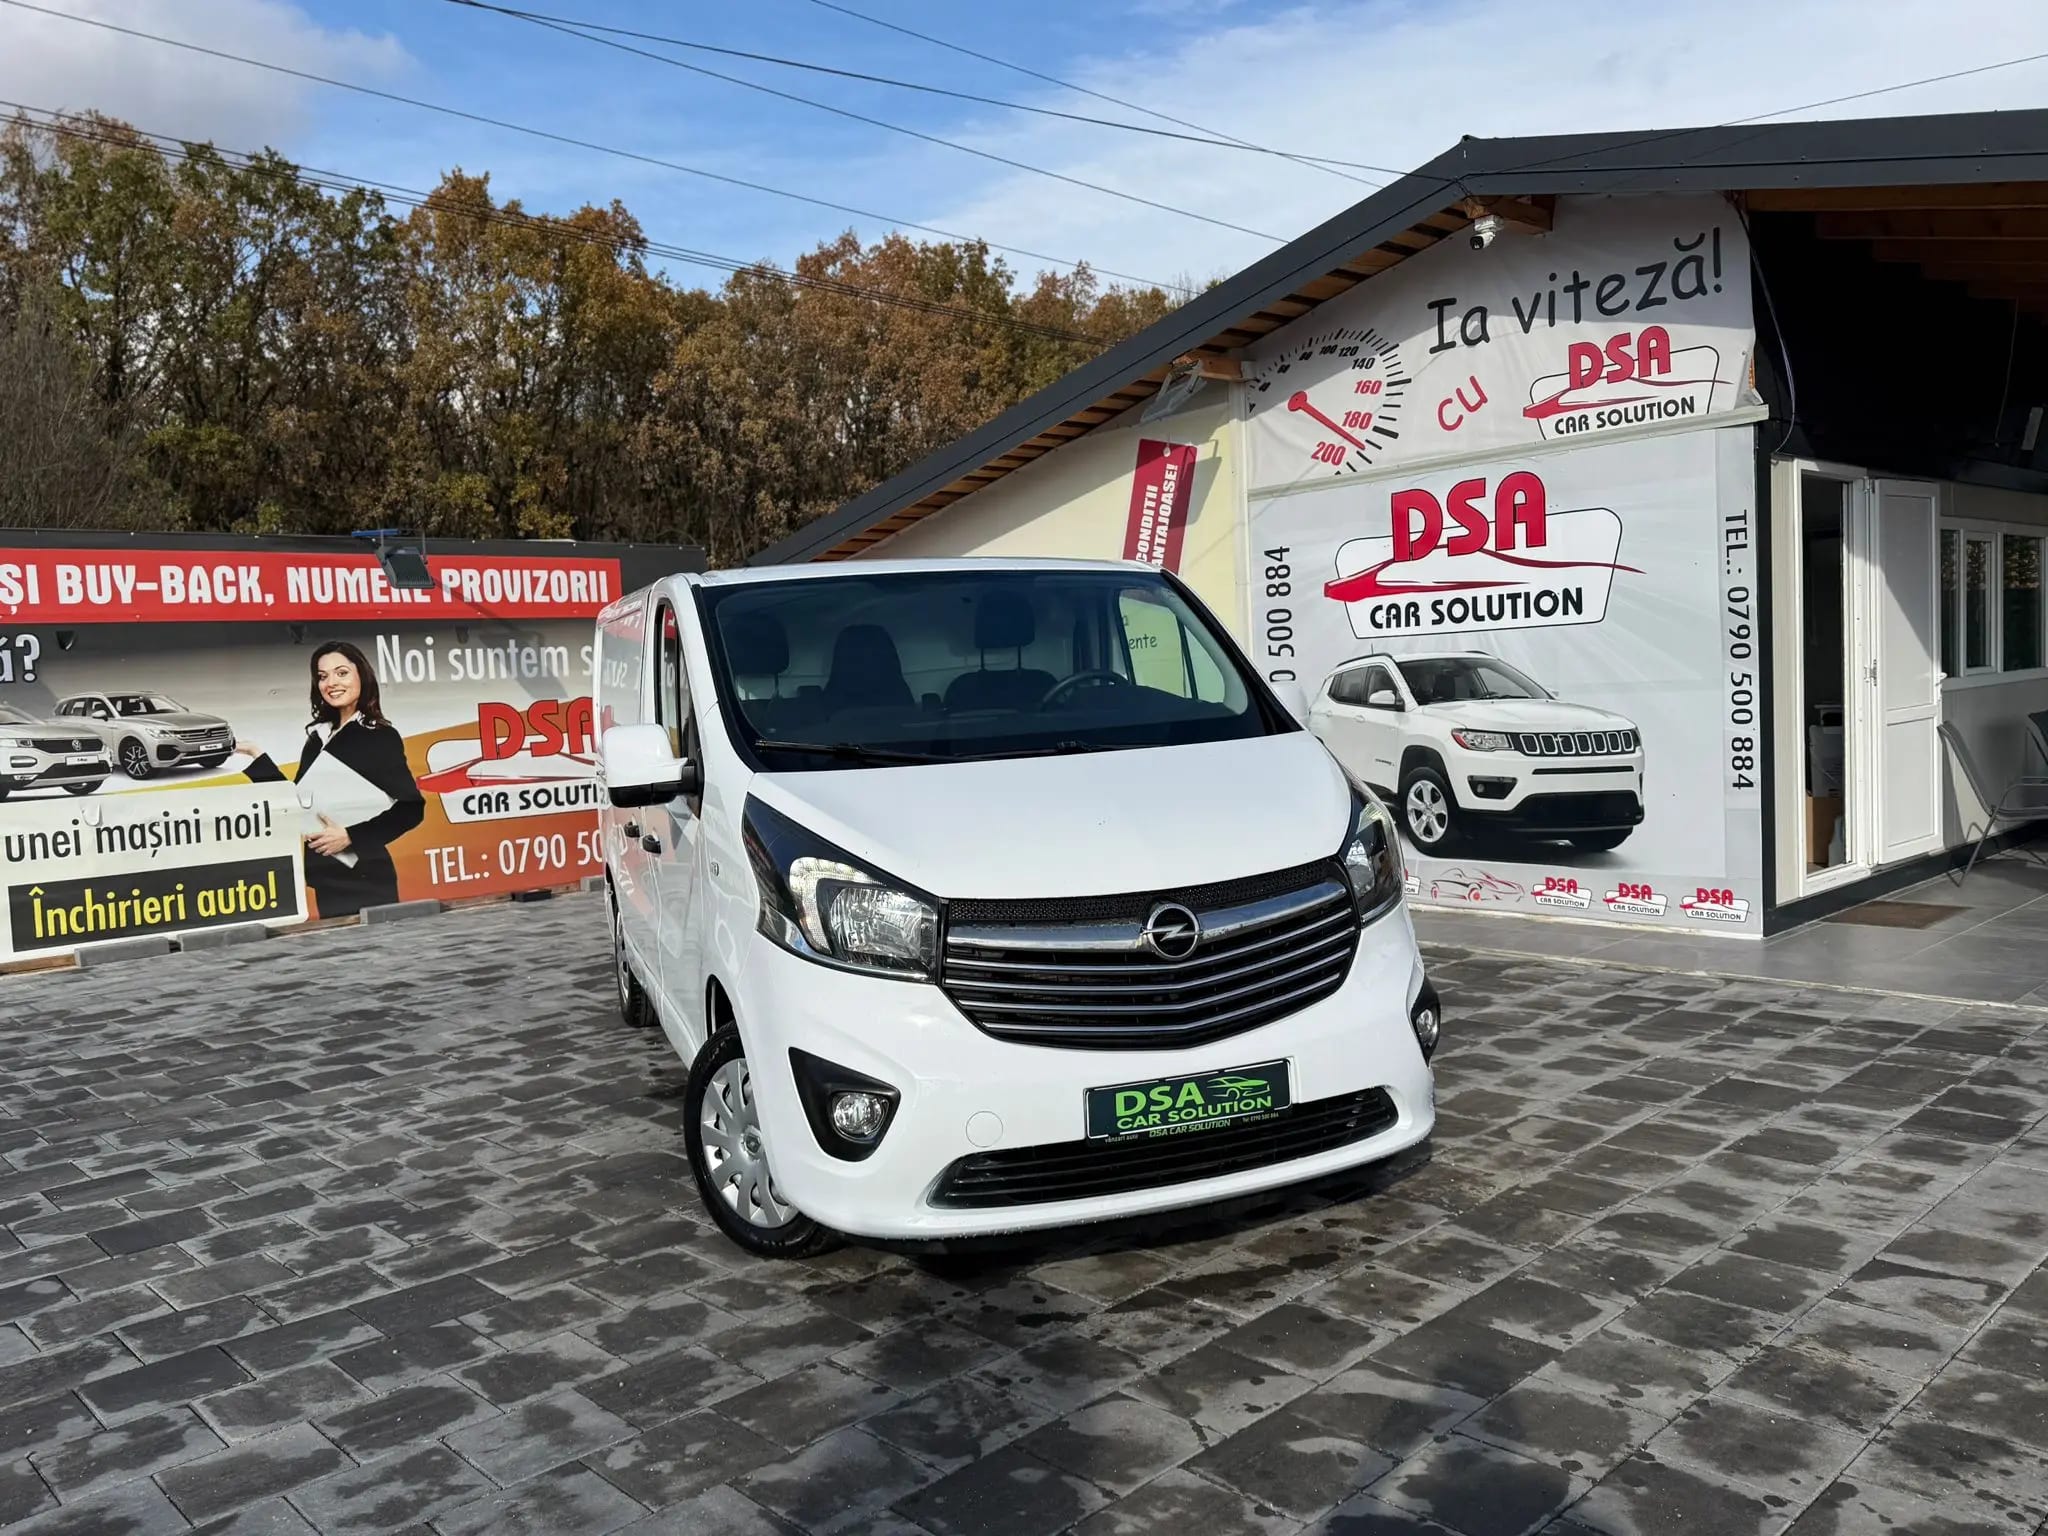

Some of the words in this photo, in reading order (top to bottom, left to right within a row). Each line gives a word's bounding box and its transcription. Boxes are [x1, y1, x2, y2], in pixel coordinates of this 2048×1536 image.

[1427, 297, 1490, 354] Ia
[1512, 227, 1722, 334] viteză!
[1338, 346, 1359, 357] 120
[1352, 357, 1375, 369] 140
[1568, 325, 1671, 390] DSA
[1354, 380, 1382, 395] 160
[1437, 375, 1488, 431] cu
[1342, 411, 1373, 429] 180
[1554, 415, 1589, 435] CAR
[1597, 395, 1695, 429] SOLUTION
[1311, 441, 1346, 466] 200
[1391, 471, 1547, 562] DSA
[0, 564, 40, 615] ȘI
[56, 564, 275, 606] BUY-BACK,
[441, 568, 609, 603] PROVIZORII
[1264, 546, 1292, 597] 884
[1370, 603, 1420, 629] CAR
[1431, 587, 1583, 625] SOLUTION
[1727, 586, 1751, 660] 0790
[1266, 608, 1295, 657] 500
[376, 635, 436, 684] Noi
[450, 639, 570, 681] suntem
[1730, 672, 1753, 725] 500
[478, 697, 596, 760] DSA
[1731, 736, 1754, 790] 884
[463, 791, 509, 815] CAR
[5, 819, 81, 863] unei
[96, 808, 201, 858] mașini
[215, 800, 272, 841] noi!
[499, 834, 566, 875] 0790
[28, 883, 186, 938] Închirieri
[197, 871, 278, 918] auto!
[1545, 877, 1578, 894] DSA
[1553, 898, 1585, 908] SOLUTION
[1618, 883, 1652, 900] DSA
[1696, 888, 1734, 905] DSA
[1627, 906, 1660, 915] SOLUTION
[1705, 911, 1741, 920] SOLUTION
[1115, 1082, 1205, 1117] DSA
[1117, 1114, 1161, 1130] CAR
[1168, 1096, 1272, 1122] SOLUTION
[1149, 1129, 1168, 1138] DSA
[1169, 1125, 1187, 1135] CAR
[1189, 1119, 1231, 1133] SOLUTION
